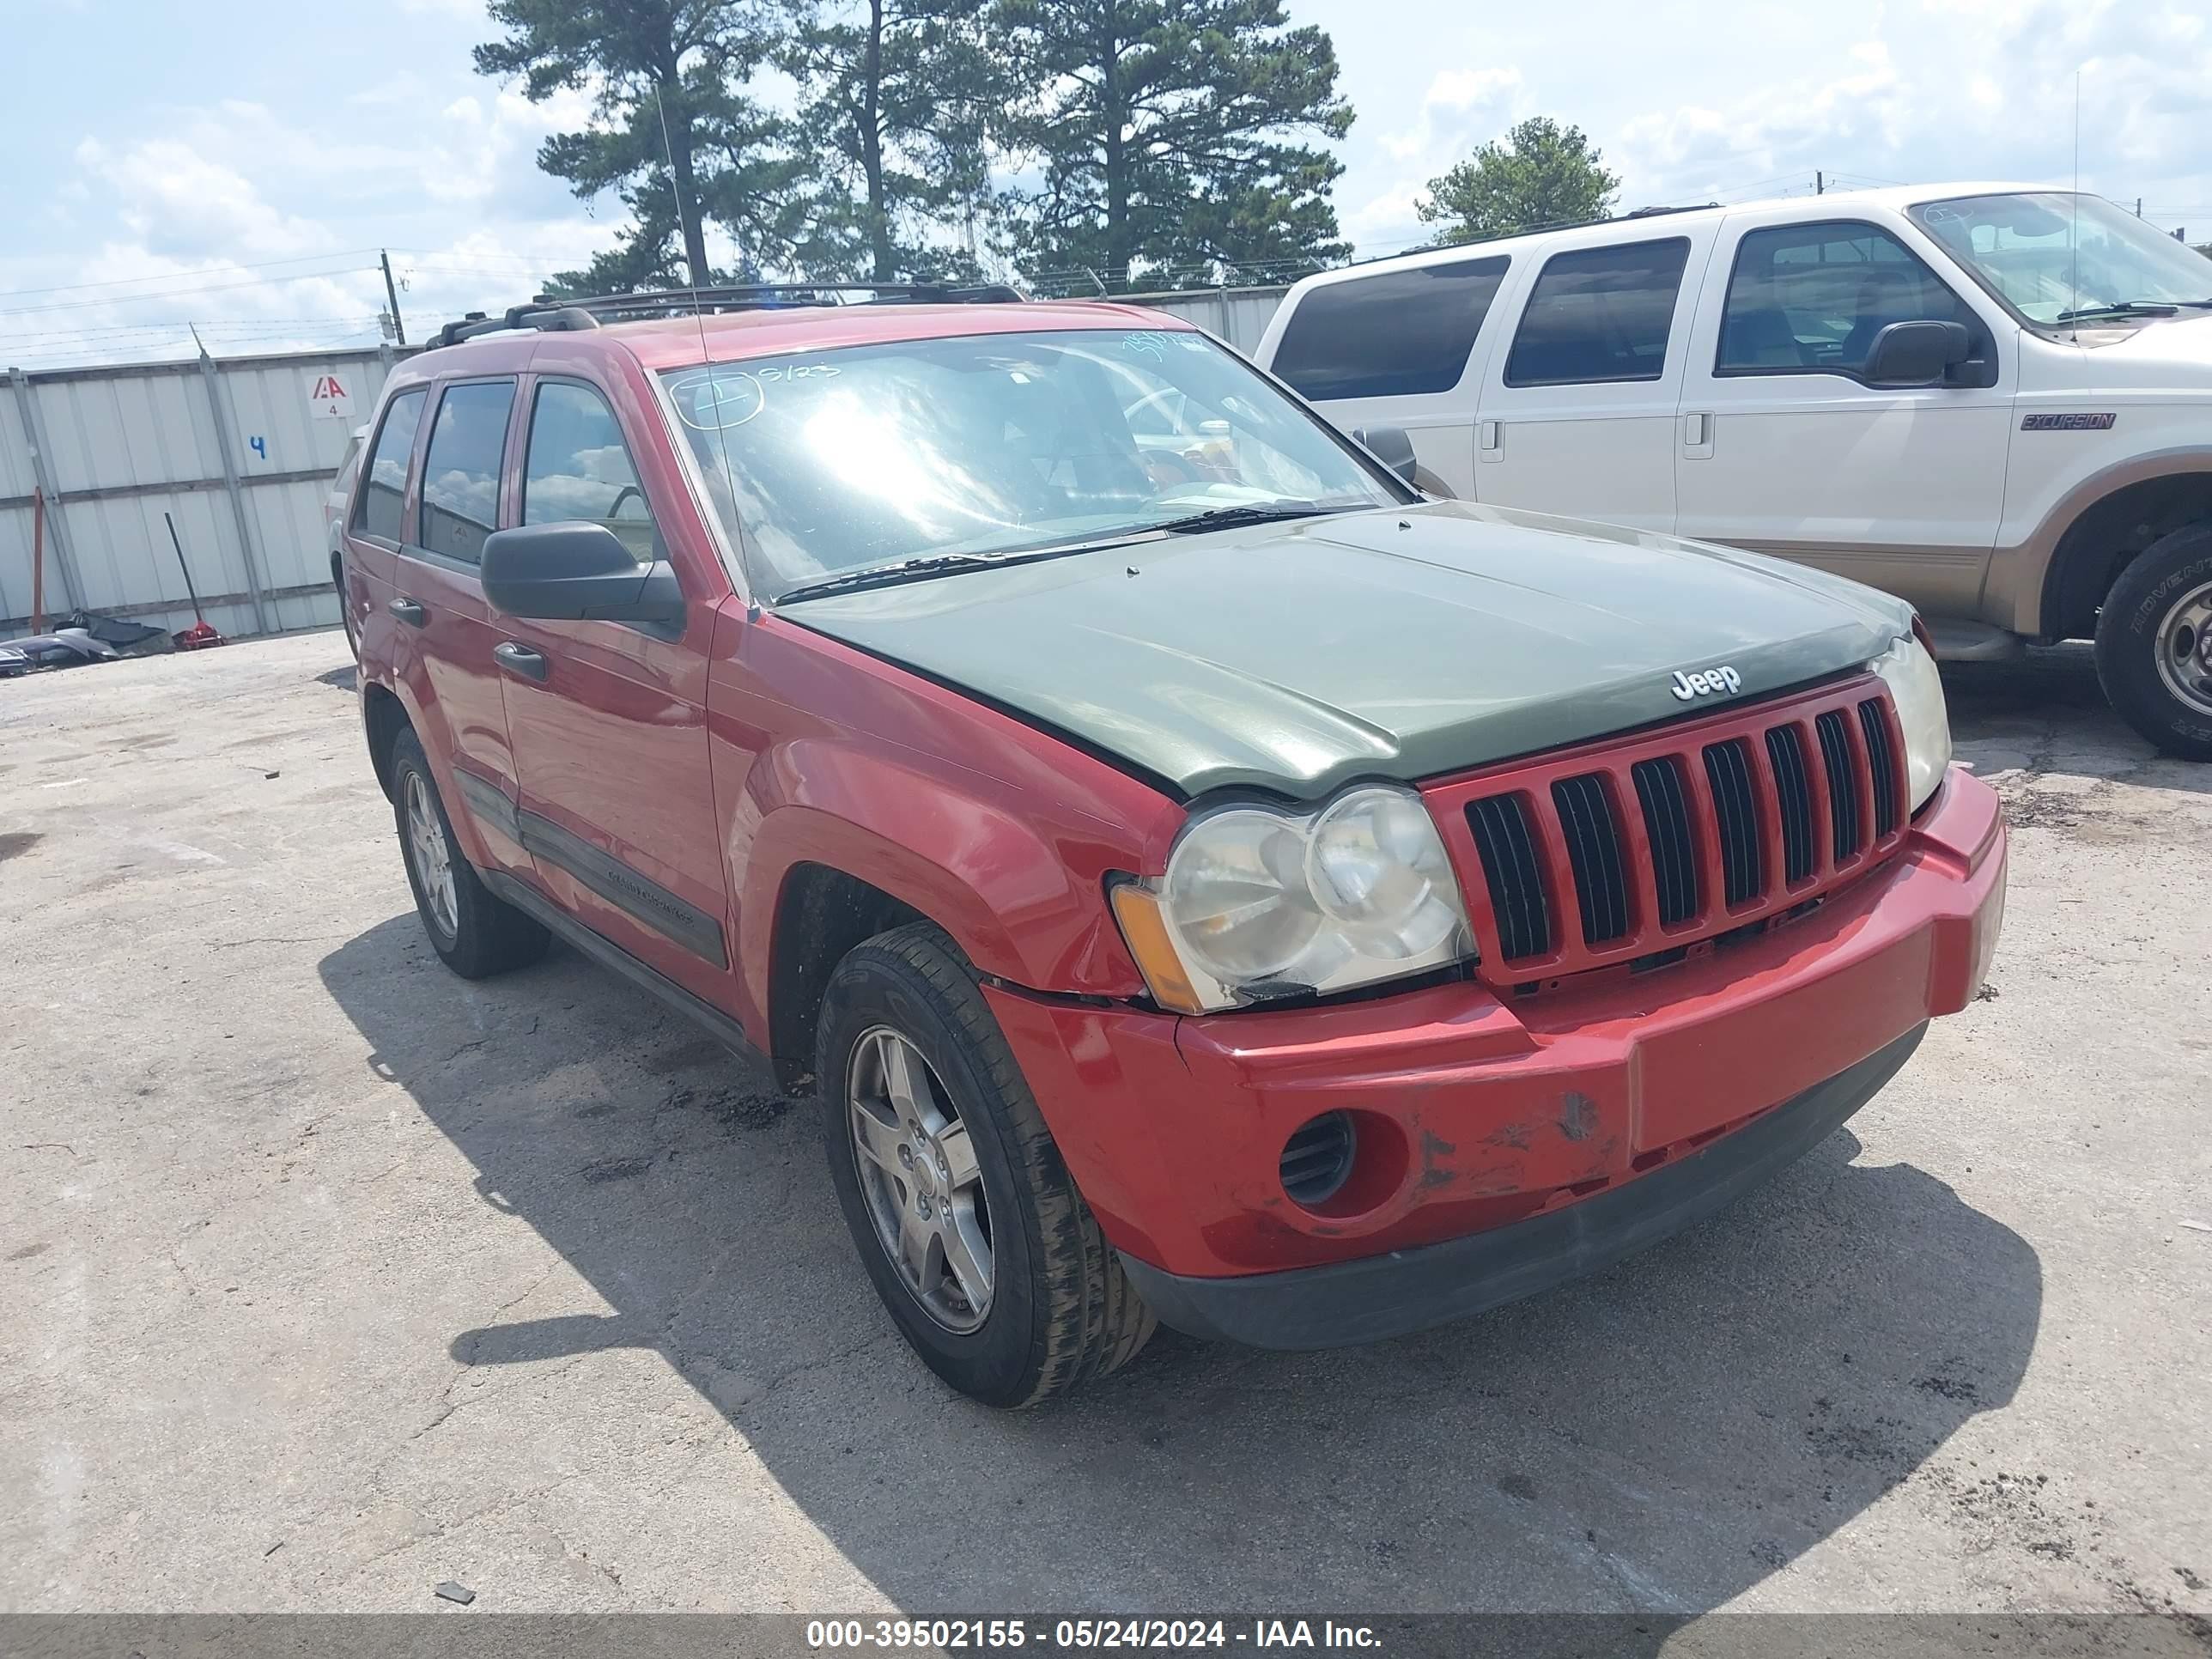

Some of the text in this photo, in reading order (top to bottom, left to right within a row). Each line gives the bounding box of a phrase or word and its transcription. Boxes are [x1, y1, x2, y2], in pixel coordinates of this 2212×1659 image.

[329, 404, 337, 415] 4
[2022, 414, 2115, 429] EXCURSION
[251, 436, 265, 459] 4
[1670, 665, 1741, 701] Jeep
